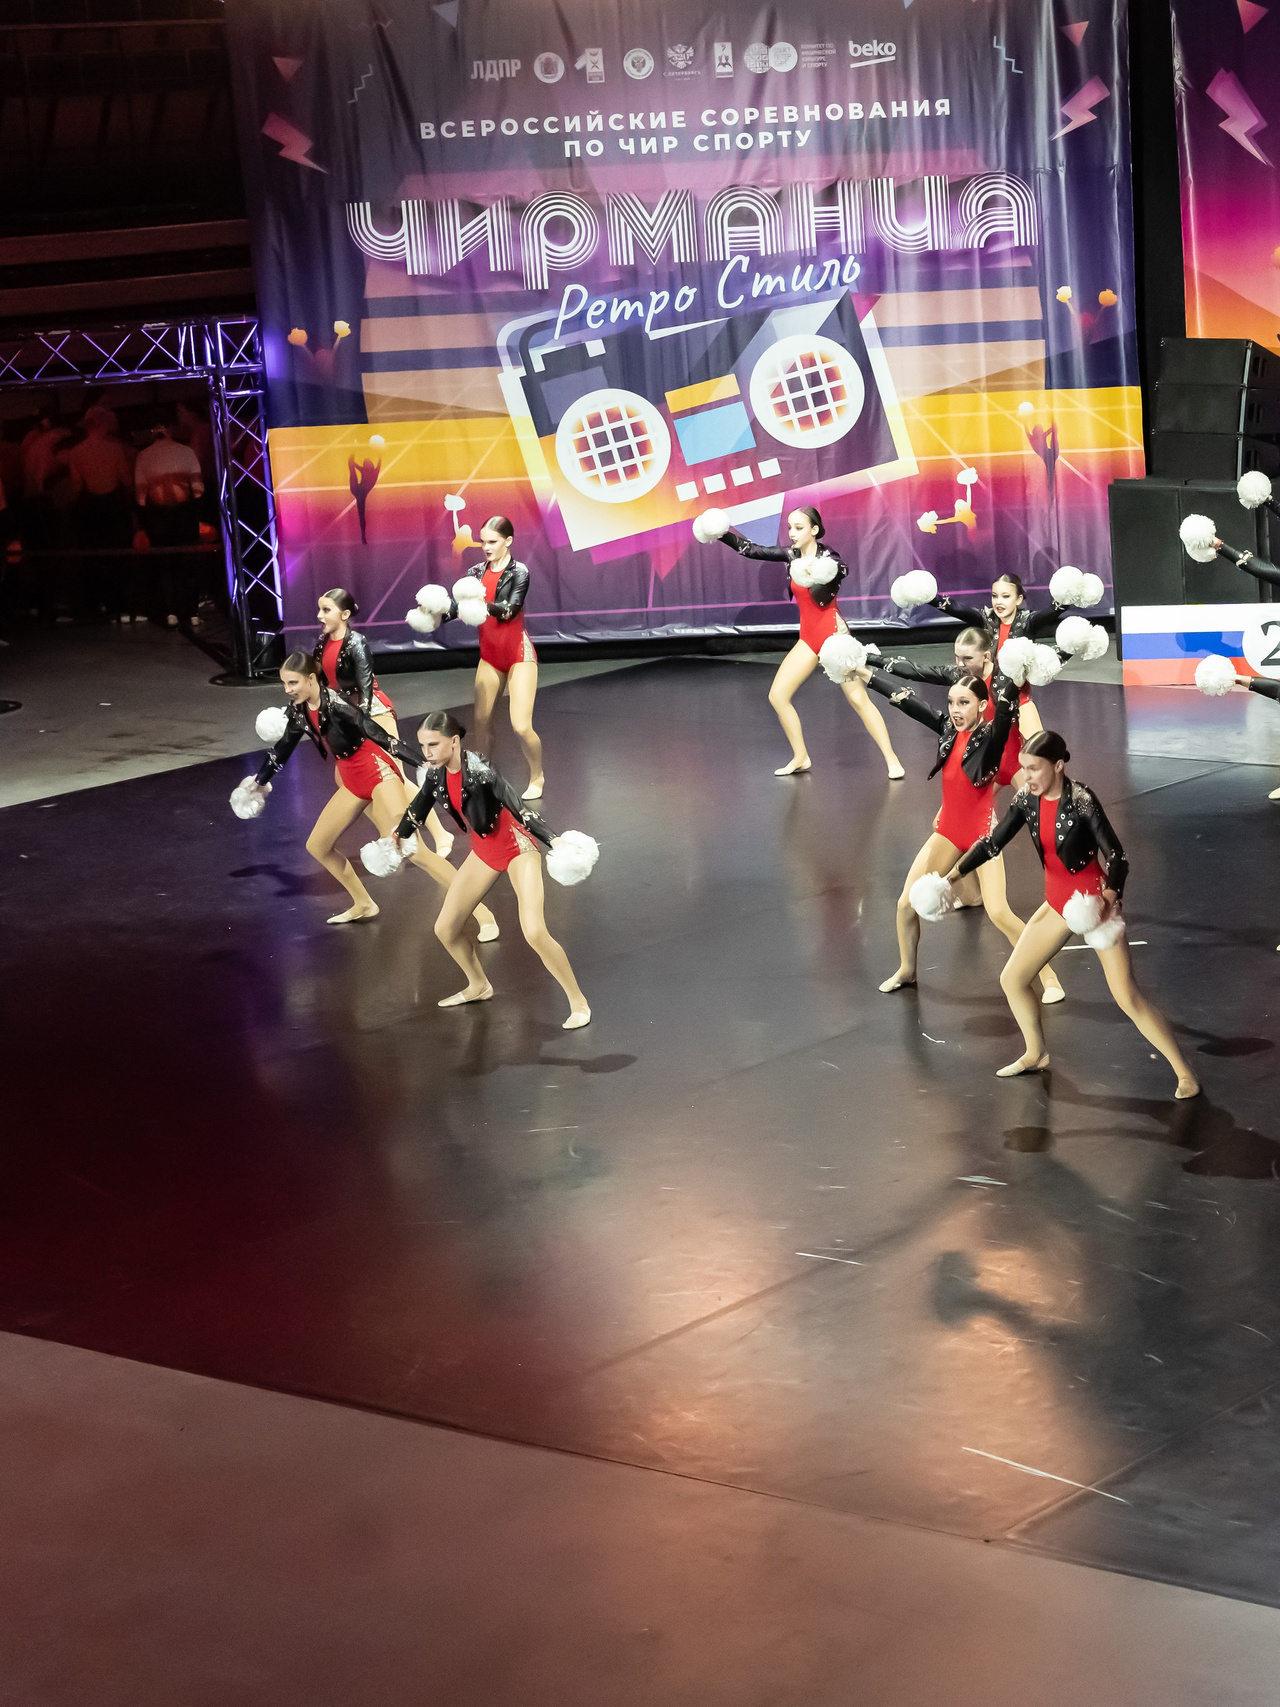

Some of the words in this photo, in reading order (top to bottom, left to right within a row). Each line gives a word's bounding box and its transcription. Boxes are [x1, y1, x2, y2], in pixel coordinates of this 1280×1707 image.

[849, 40, 897, 58] beko
[471, 59, 522, 82] ЛДПР
[420, 109, 687, 139] ВСЕРОССИЙСКИЕ
[701, 98, 952, 127] СОРЕВНОВАНИЯ
[563, 139, 604, 158] ПО
[617, 135, 679, 155] ЧИР
[693, 129, 812, 151] СПОРТУ
[554, 284, 698, 340] Ретро
[717, 255, 861, 309] Стиль
